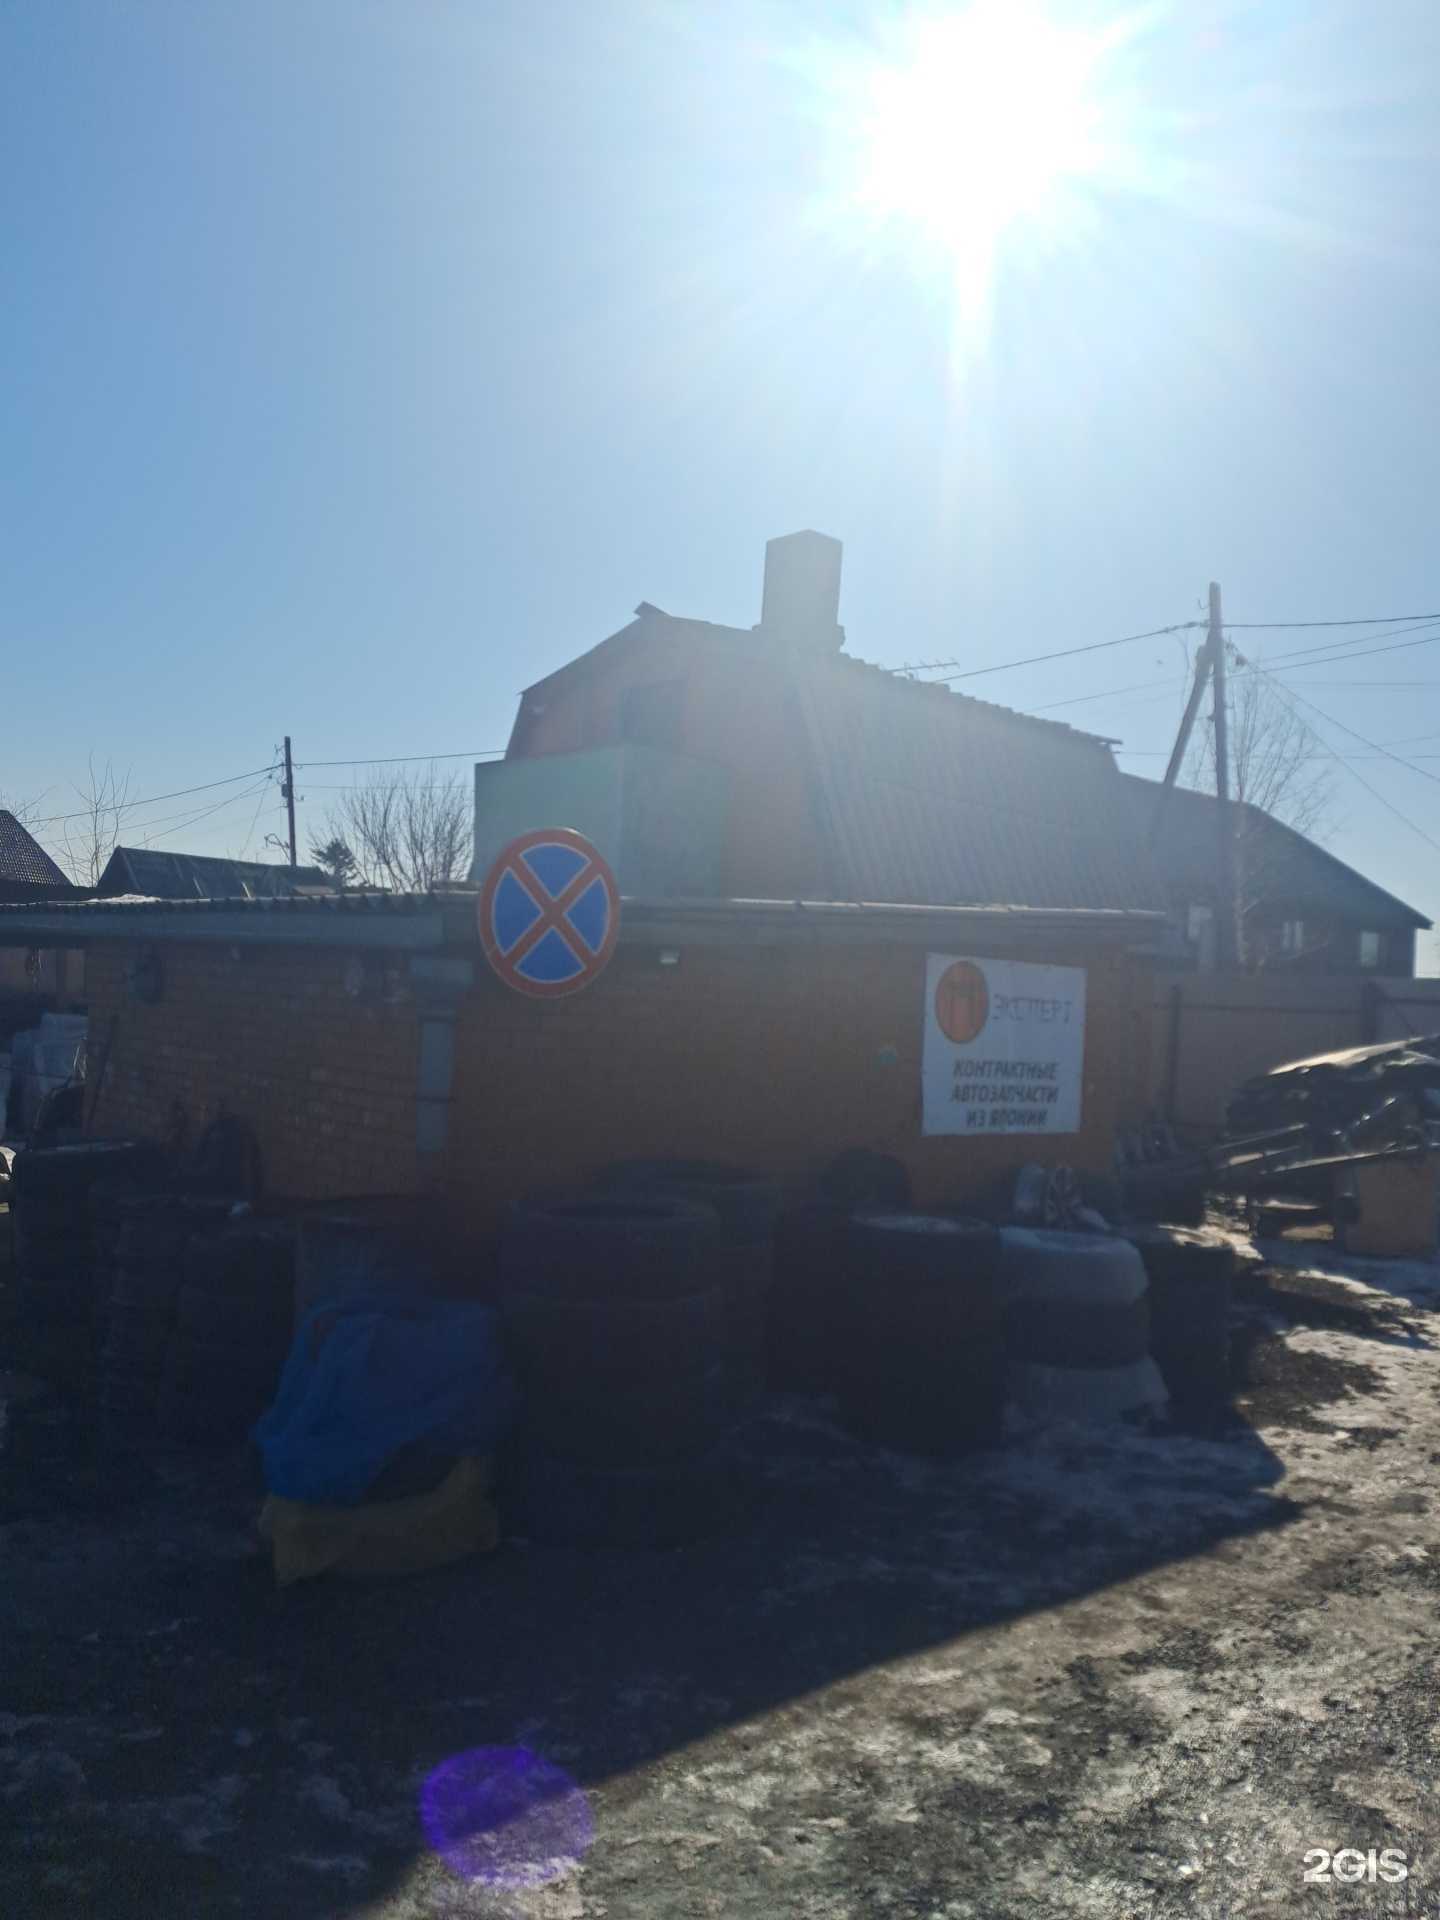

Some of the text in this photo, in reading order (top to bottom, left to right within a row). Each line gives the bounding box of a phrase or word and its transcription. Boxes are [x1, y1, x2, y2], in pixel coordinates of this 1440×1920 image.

[952, 1059, 1060, 1080] КОНТРАКТНЫЕ
[951, 1084, 1060, 1104] АВТОЗАПЧАСТИ
[966, 1109, 986, 1128] ИЗ
